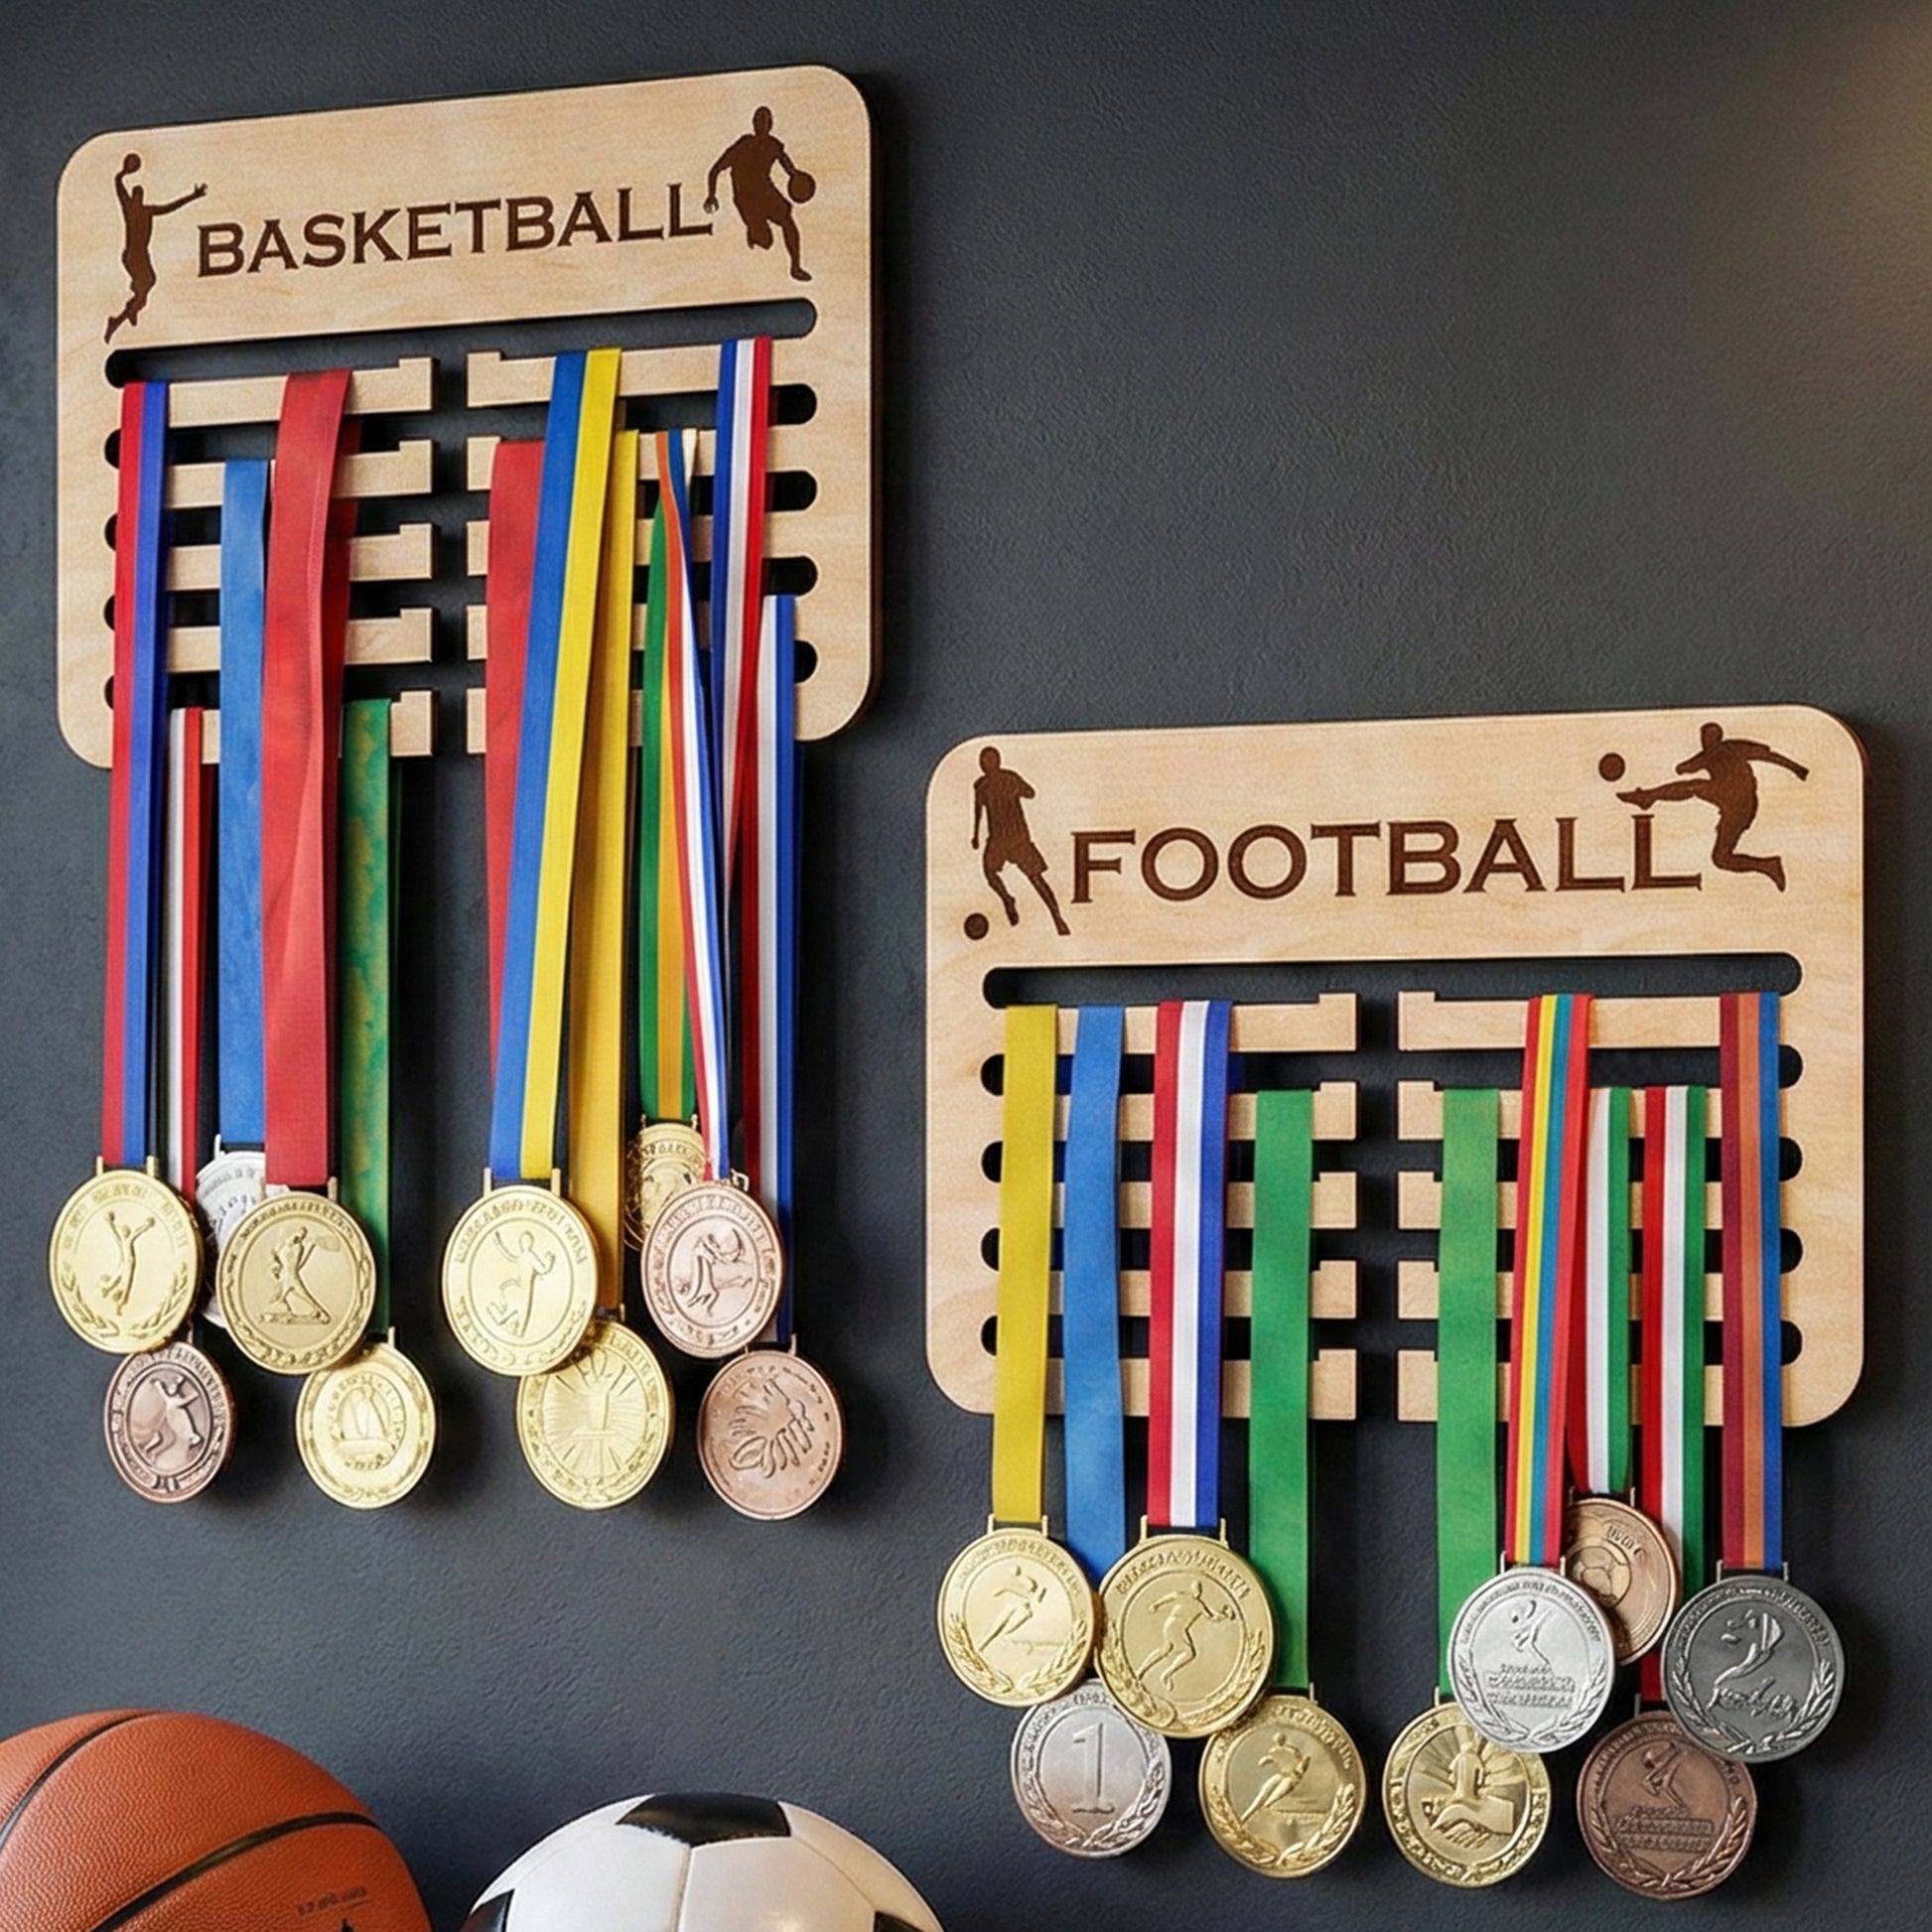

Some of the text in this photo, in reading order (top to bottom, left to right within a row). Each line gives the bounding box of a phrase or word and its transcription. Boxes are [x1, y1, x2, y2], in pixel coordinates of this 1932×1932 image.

[198, 183, 713, 277] BASKETBALL
[1070, 814, 1702, 904] FOOTBALL
[1072, 1722, 1115, 1815] 1
